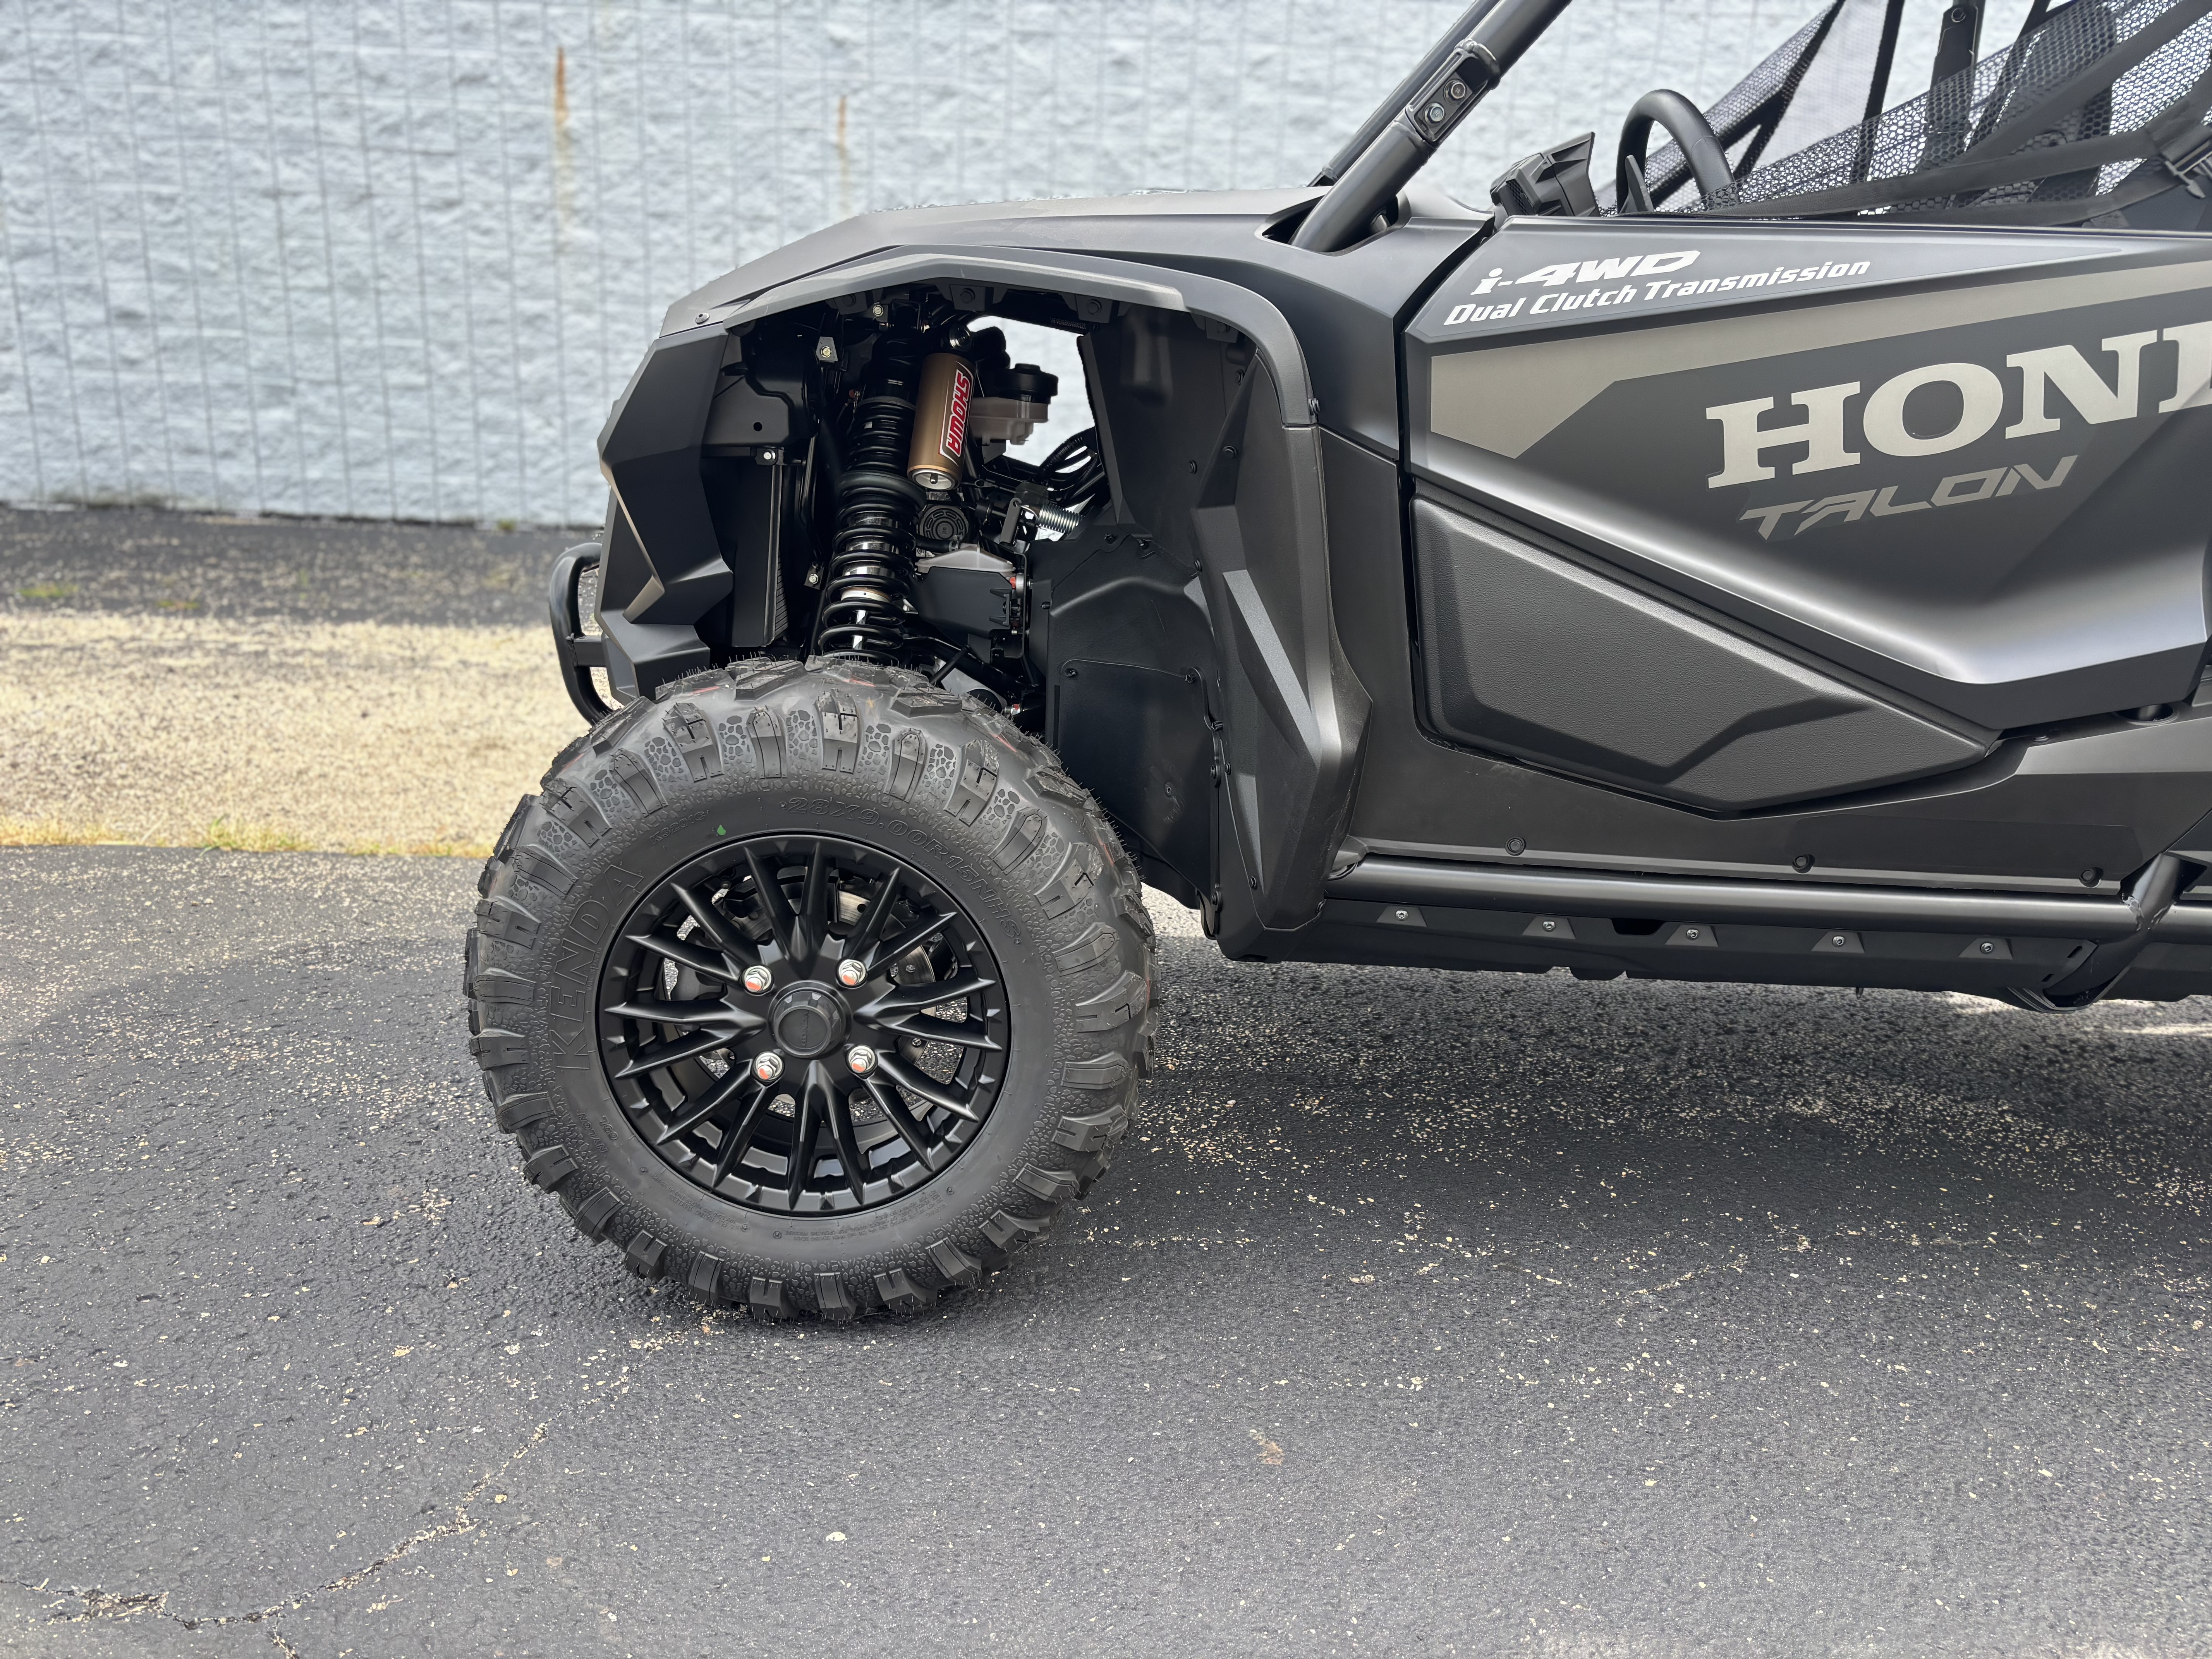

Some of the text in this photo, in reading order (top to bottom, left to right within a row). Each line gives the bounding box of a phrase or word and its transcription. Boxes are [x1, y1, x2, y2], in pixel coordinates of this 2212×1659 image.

[1443, 261, 1870, 325] Dual Clutch Transmission
[1470, 250, 1700, 295] i-4WD
[946, 369, 970, 457] SHOWA
[1739, 455, 2078, 541] TALON
[649, 811, 706, 845] K3201C
[550, 864, 644, 1069] KENDA
[577, 1113, 608, 1153] NYLON
[599, 1115, 618, 1140] 69L
